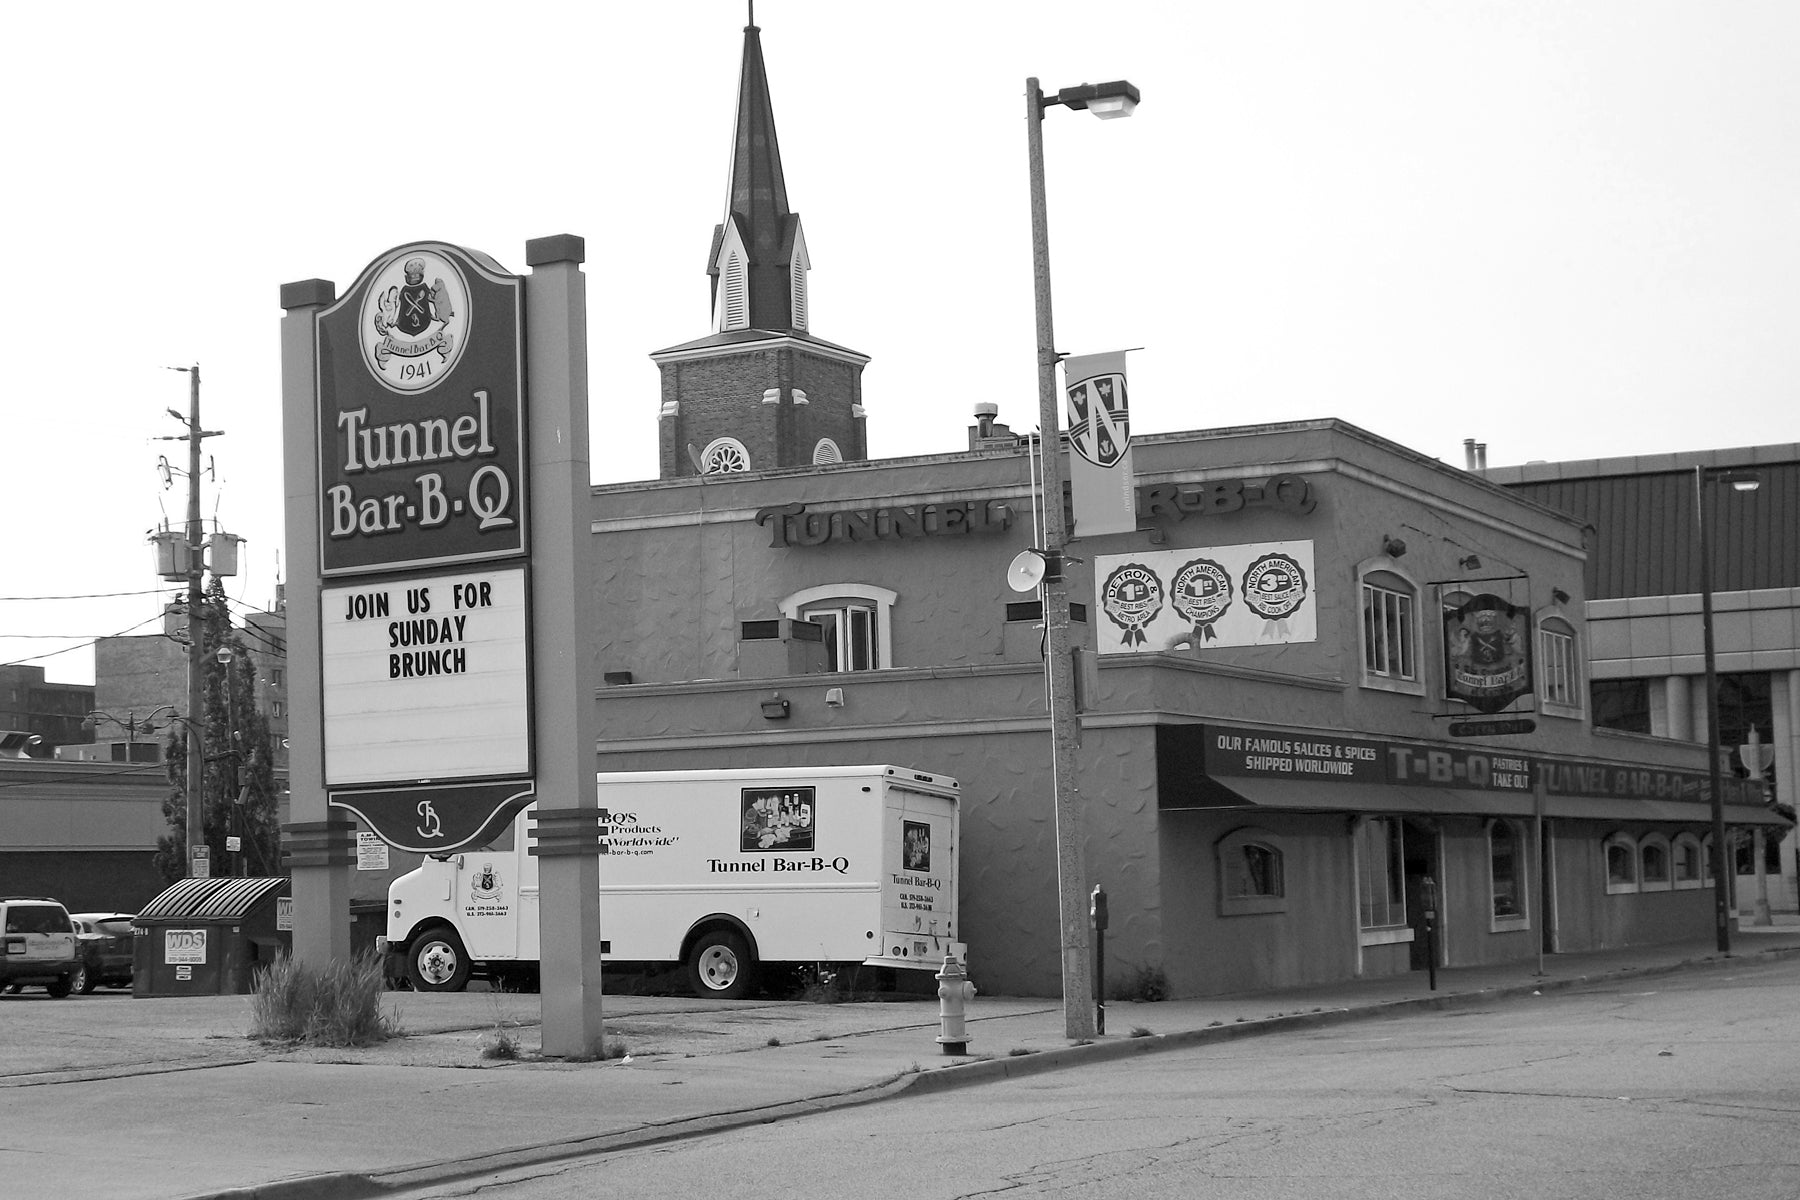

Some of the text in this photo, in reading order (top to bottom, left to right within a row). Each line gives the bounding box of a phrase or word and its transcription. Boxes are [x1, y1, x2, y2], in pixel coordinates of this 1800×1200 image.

[400, 360, 432, 380] 1941
[338, 390, 494, 471] Tunnel
[755, 502, 1014, 548] TUNNEL
[1108, 570, 1158, 598] DETROIT &
[1176, 565, 1227, 594] NORTH AMERICAN
[1248, 560, 1300, 589] NORTH AMERICAN
[345, 581, 492, 620] JOIN US FOR
[1120, 602, 1134, 610] BEST
[1135, 601, 1147, 609] RIBS
[1203, 597, 1216, 605] RIBS
[1261, 592, 1274, 600] BEST
[1274, 591, 1289, 600] SAUCE
[1117, 611, 1151, 623] METRO AREA
[1185, 606, 1220, 619] CHAMPIONS
[1267, 606, 1282, 614] COOK
[388, 615, 466, 648] SUNDAY
[389, 648, 466, 679] BRUNCH
[1217, 735, 1377, 761] OUR FAMOUS SAUCES & SPICES
[1246, 755, 1354, 775] SHIPPED WORLDWIDE
[1389, 747, 1490, 788] T-B-Q
[1492, 772, 1529, 789] TAKE OUT
[1536, 762, 1609, 793] TUNNEL
[611, 825, 662, 834] Products
[706, 856, 849, 874] Tunnel Bar-B-Q
[892, 873, 941, 891] Tunnel Bar-B-Q
[167, 931, 205, 949] WDS
